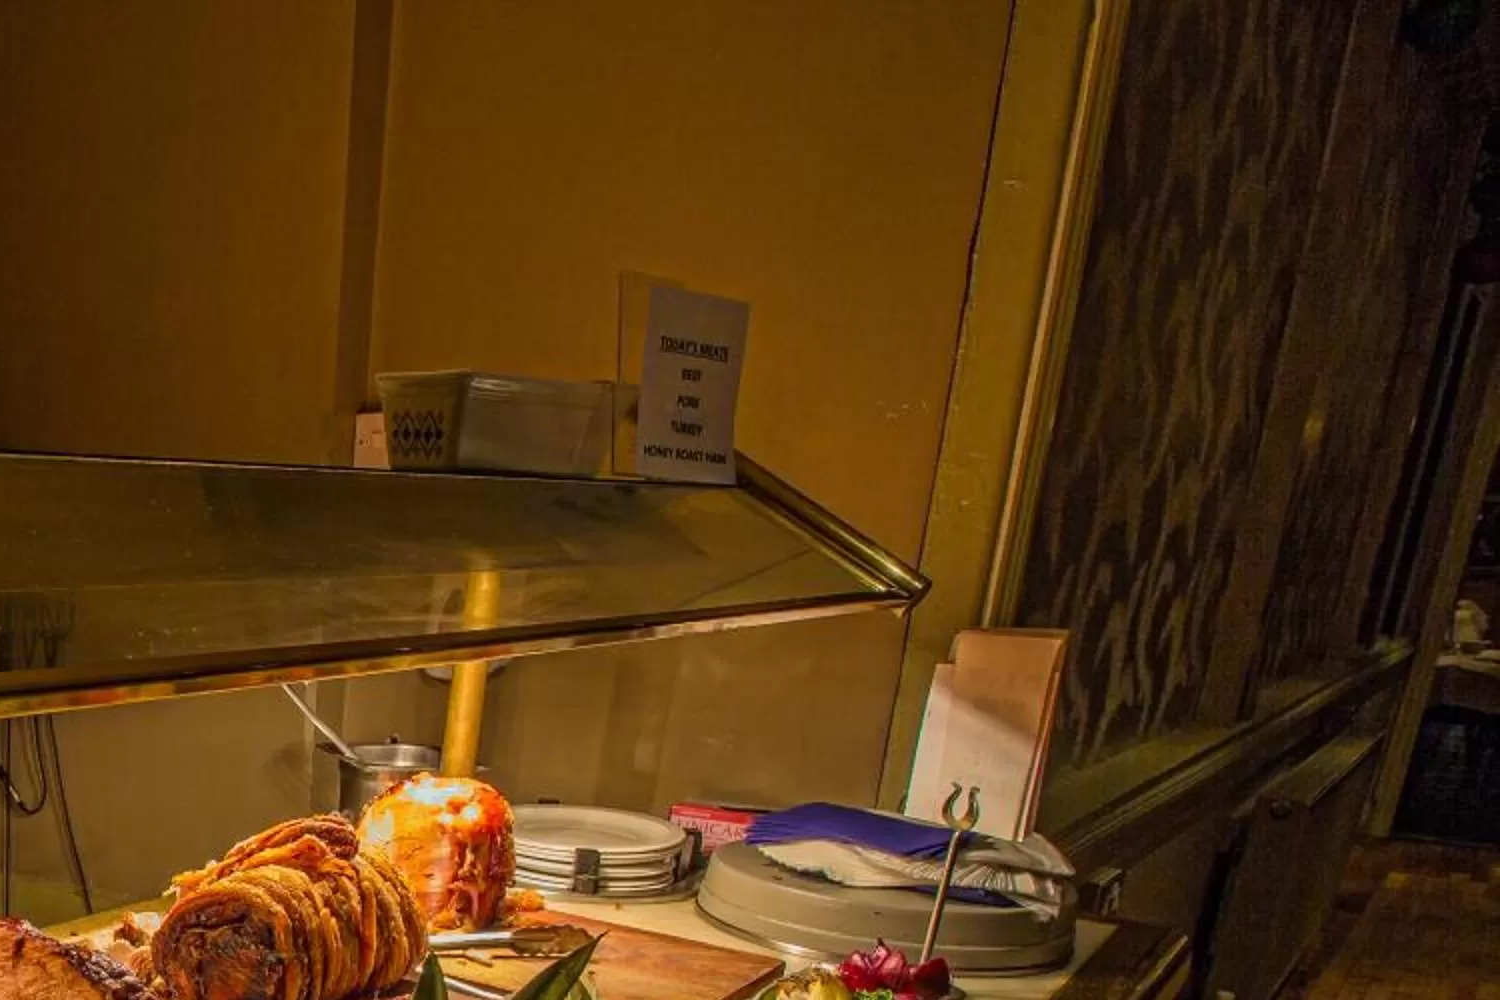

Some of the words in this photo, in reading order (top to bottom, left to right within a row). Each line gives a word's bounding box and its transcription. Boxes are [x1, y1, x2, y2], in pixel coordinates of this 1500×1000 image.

[700, 342, 729, 362] MEATS
[670, 420, 703, 436] TURKEY
[643, 444, 674, 459] HONEY
[676, 448, 704, 462] ROAST
[705, 451, 727, 464] HAM
